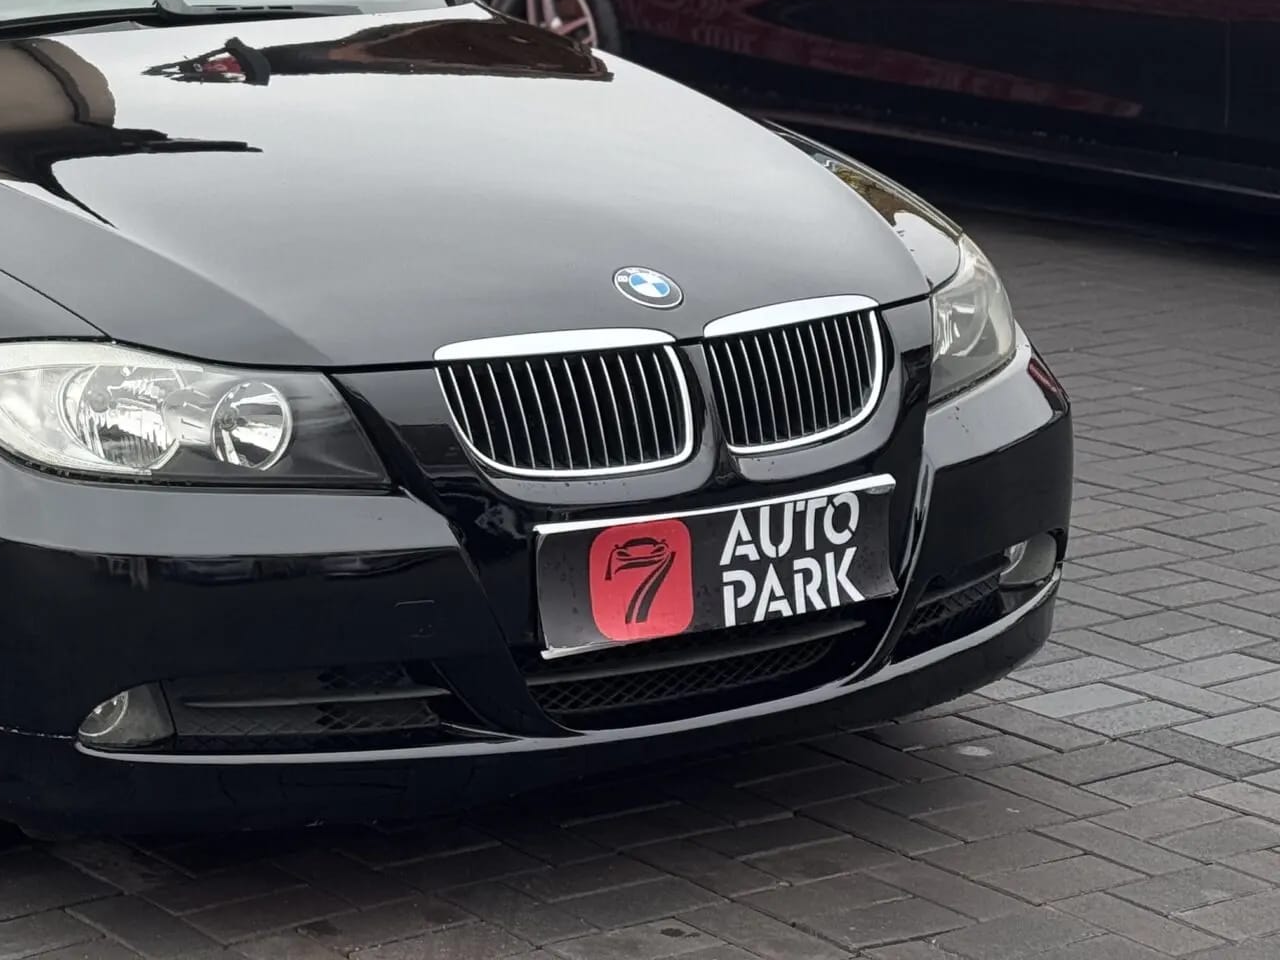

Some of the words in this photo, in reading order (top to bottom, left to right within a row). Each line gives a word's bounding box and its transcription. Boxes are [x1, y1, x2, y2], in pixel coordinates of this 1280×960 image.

[720, 493, 859, 566] AUTO
[605, 538, 677, 624] 7
[722, 547, 865, 626] PARK
